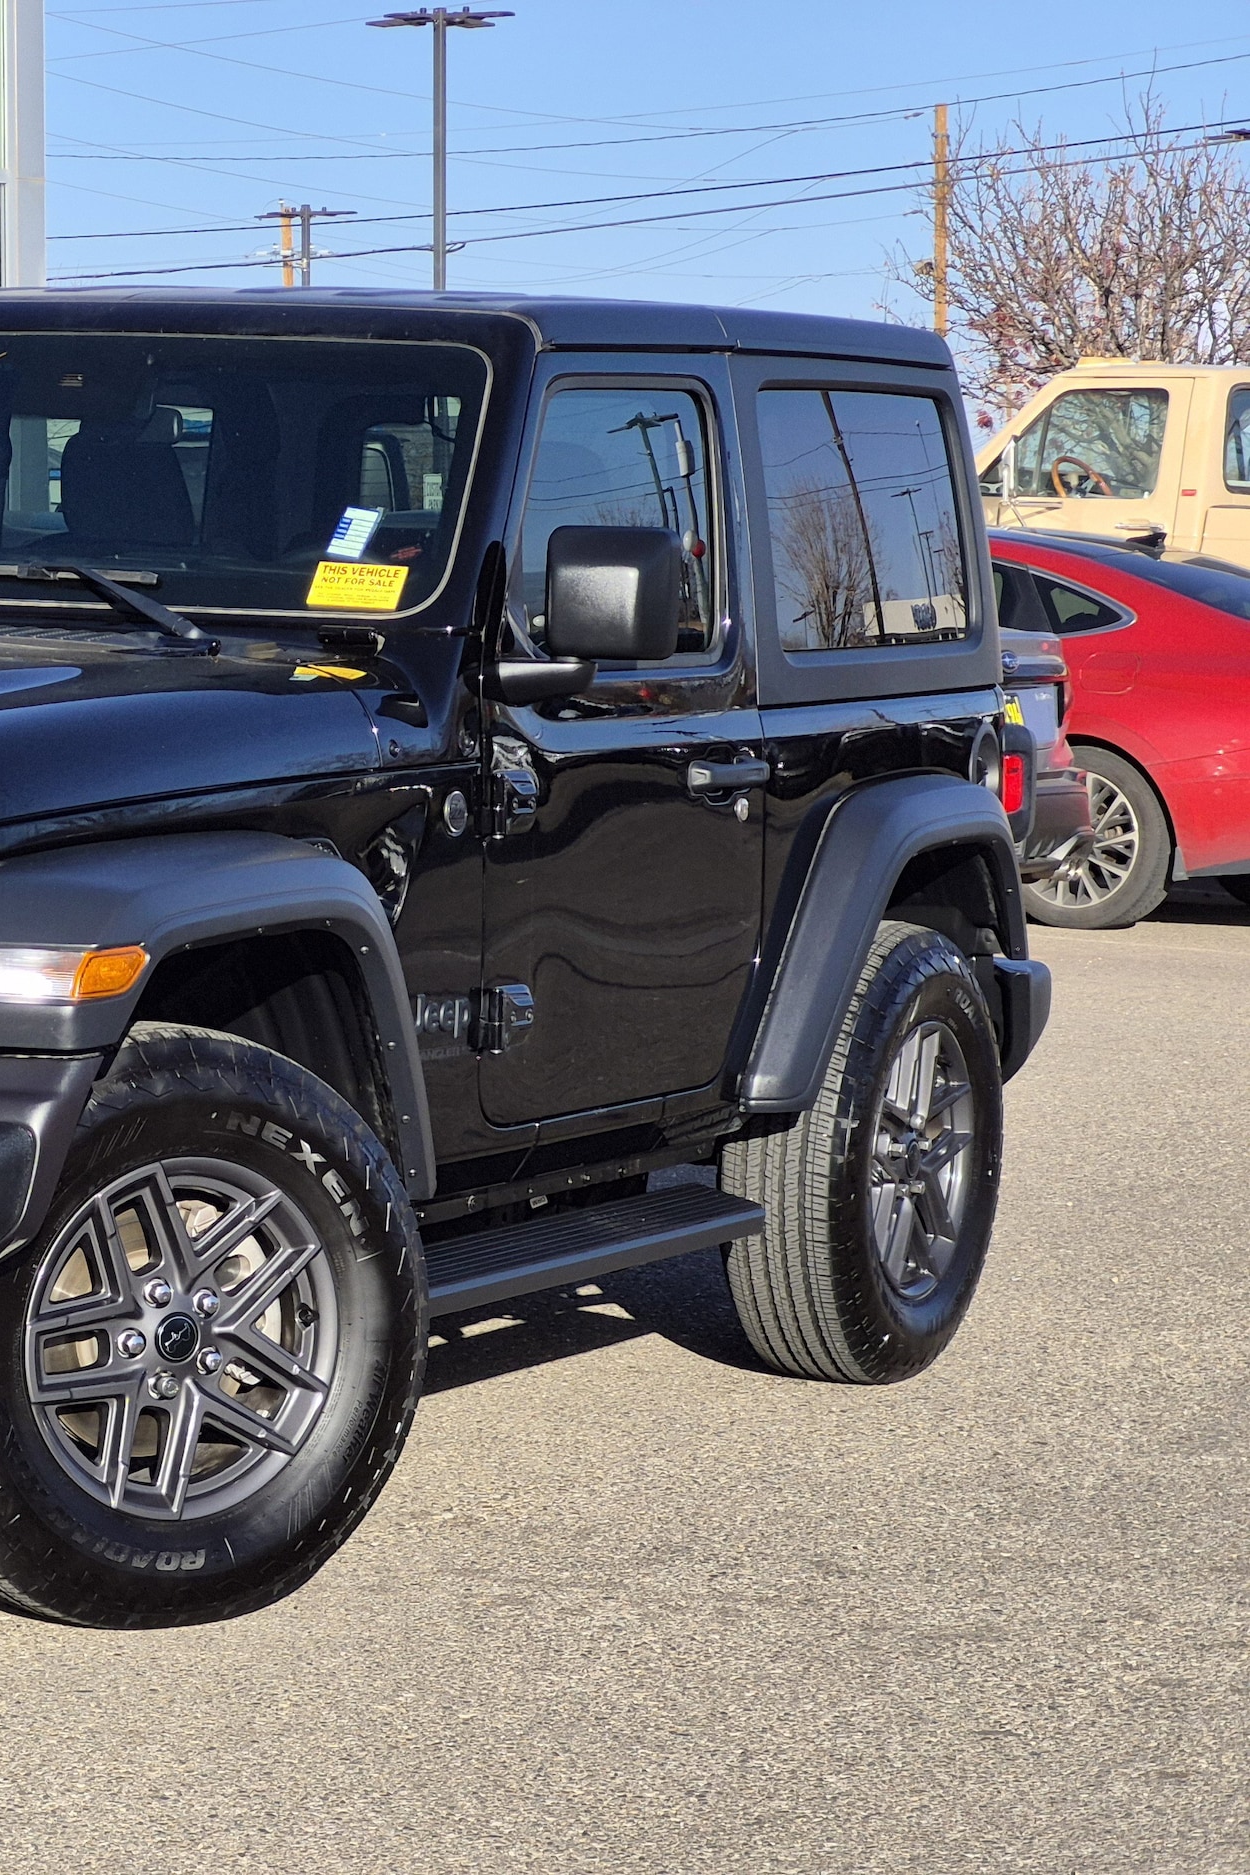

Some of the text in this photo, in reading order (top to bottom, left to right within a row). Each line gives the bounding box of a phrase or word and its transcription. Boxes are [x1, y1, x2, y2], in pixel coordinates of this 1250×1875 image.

[321, 576, 395, 588] NOT FOR SALE
[322, 564, 401, 579] THIS VEHICLE
[415, 993, 470, 1039] Jeep
[226, 1110, 370, 1237] NEXEN
[332, 1399, 363, 1457] Performance
